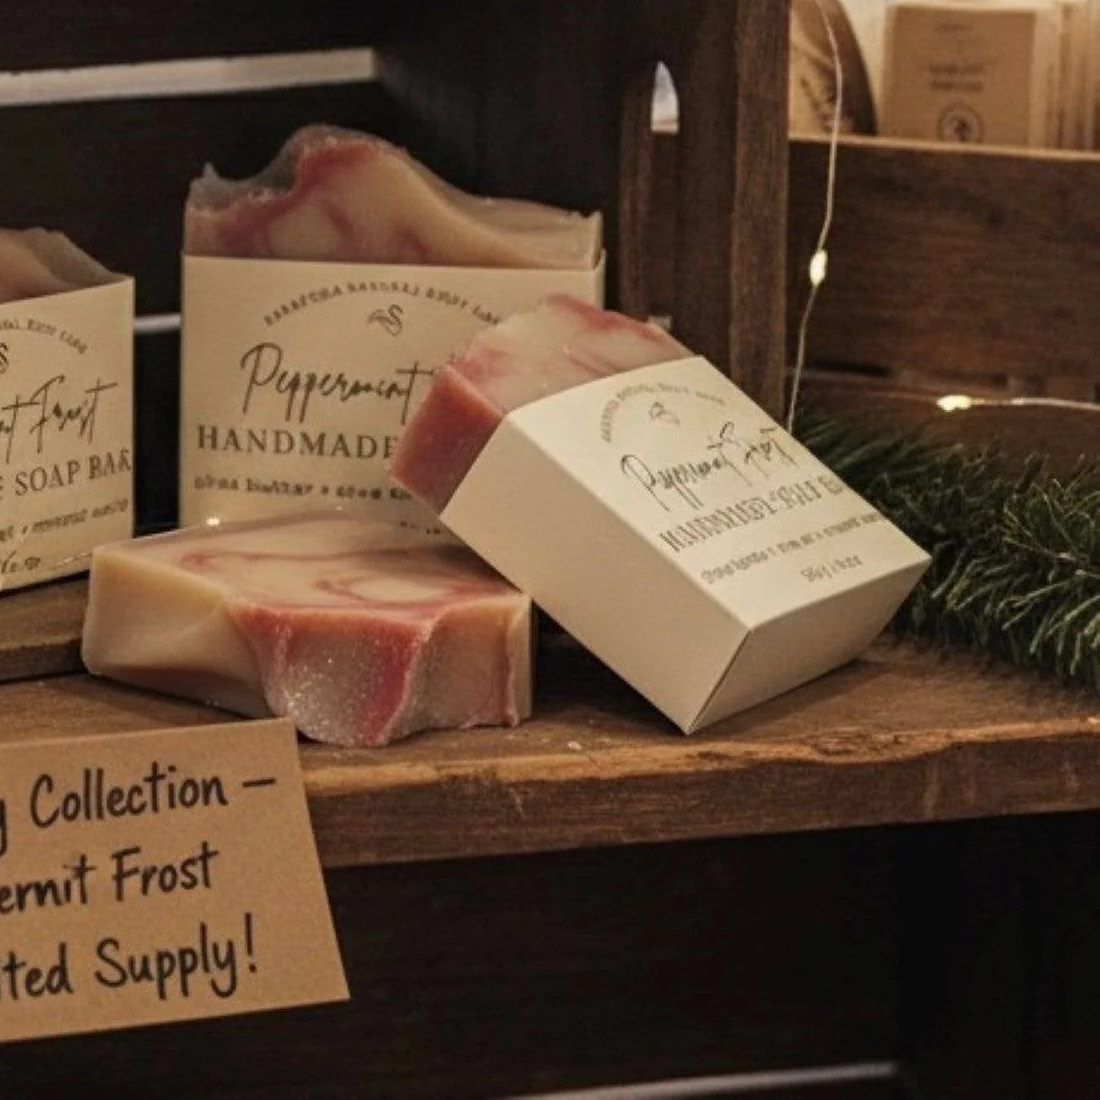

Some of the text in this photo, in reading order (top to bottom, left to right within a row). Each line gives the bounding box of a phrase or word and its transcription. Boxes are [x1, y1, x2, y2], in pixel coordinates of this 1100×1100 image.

[14, 457, 81, 497] SOAP
[30, 762, 230, 829] Collection
[111, 841, 220, 901] Frost
[94, 912, 259, 999] Supply!
